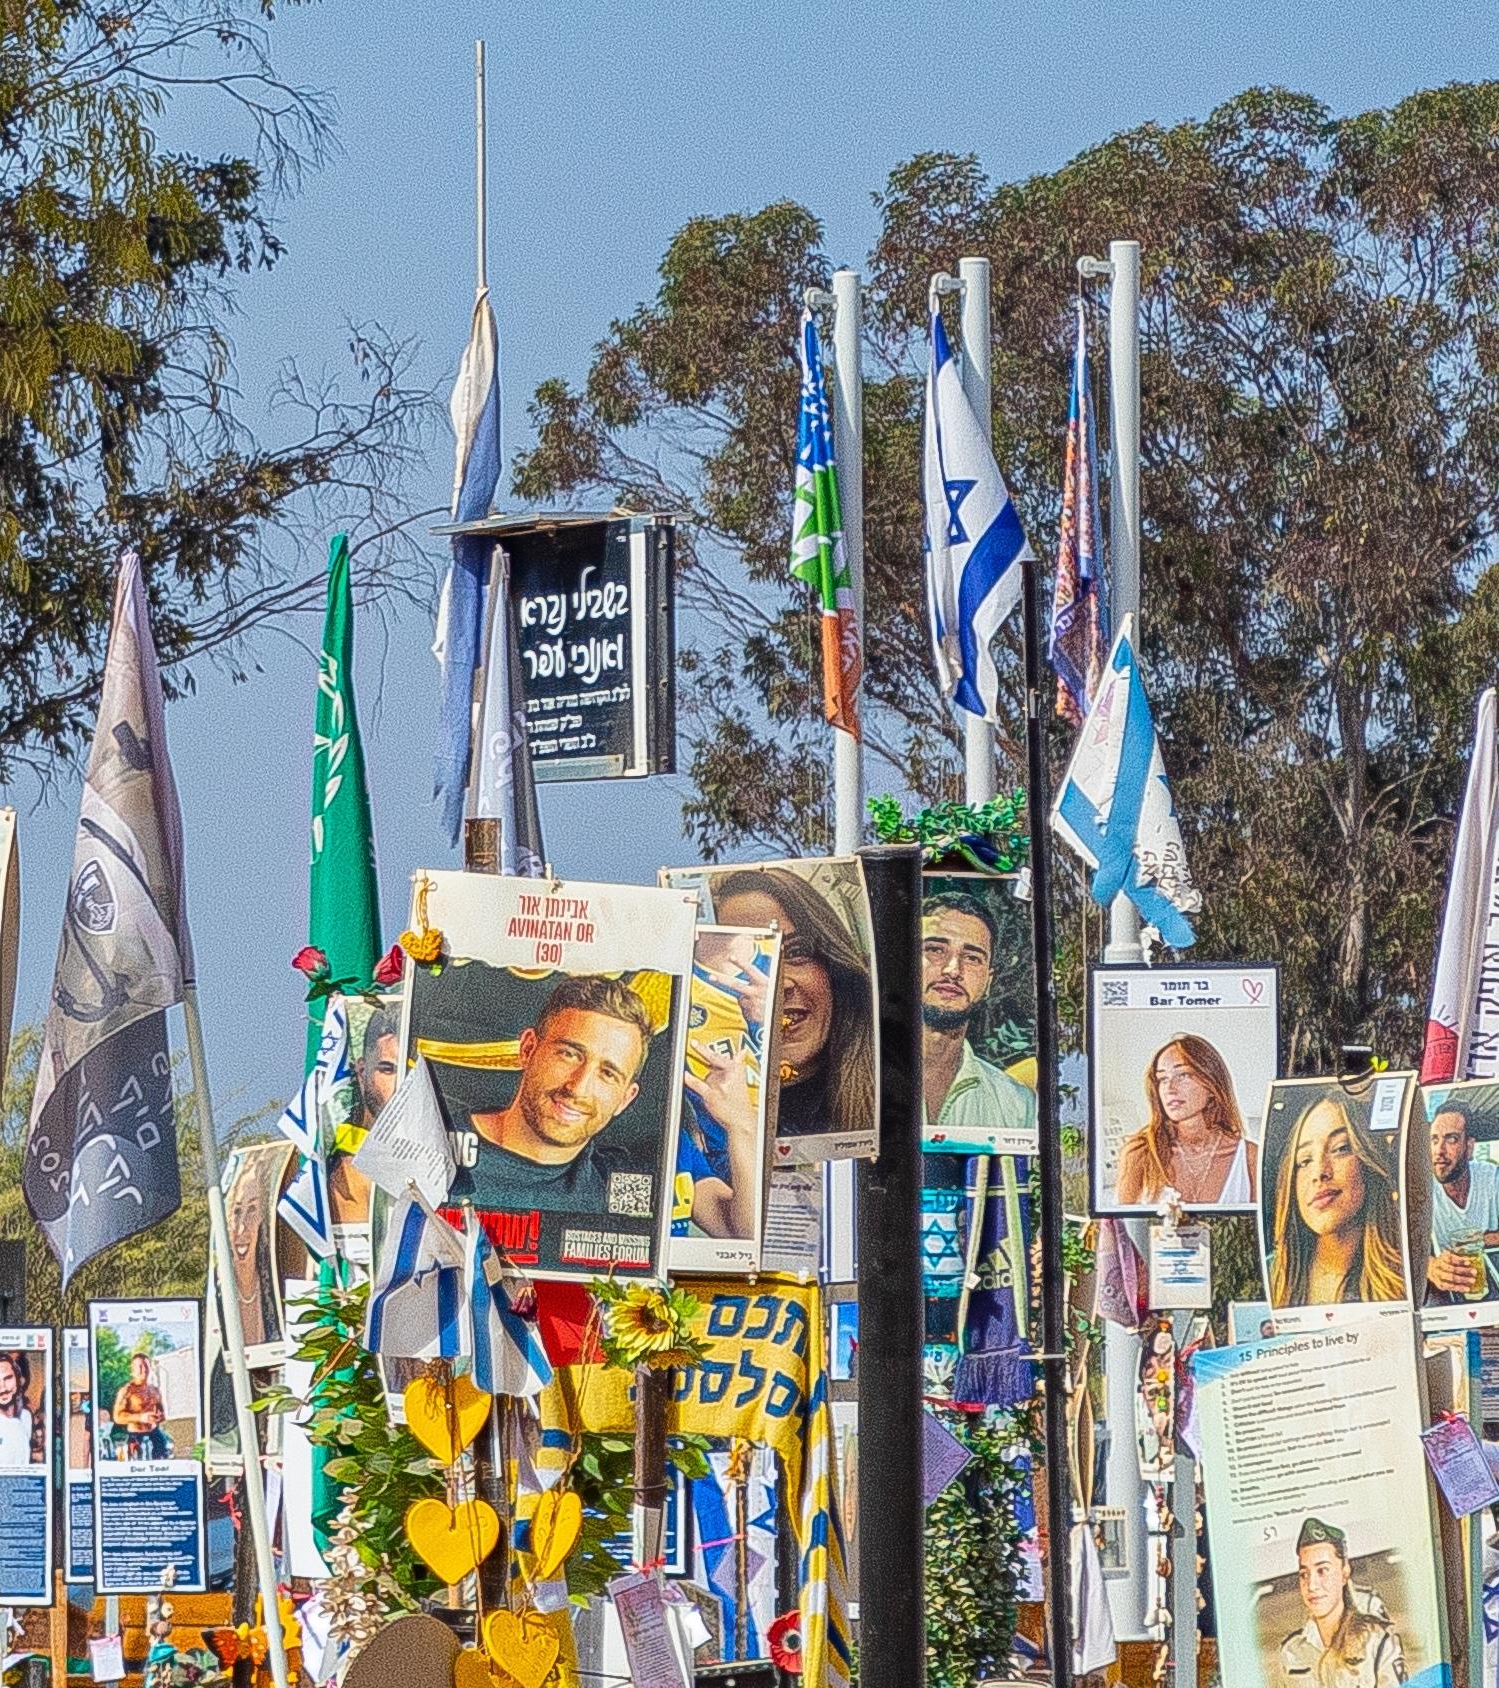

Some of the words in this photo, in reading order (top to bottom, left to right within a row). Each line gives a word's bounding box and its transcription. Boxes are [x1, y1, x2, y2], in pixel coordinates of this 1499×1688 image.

[573, 566, 629, 621] בשבילי
[521, 594, 566, 635] נברא
[523, 638, 565, 679] עפר
[571, 634, 623, 684] ואנוכי
[519, 895, 541, 915] אור
[545, 897, 589, 919] אבינתן
[508, 917, 573, 940] AVINATAN
[576, 923, 594, 943] OR
[536, 941, 563, 965] (30)
[1160, 981, 1190, 990] תומר
[1194, 981, 1209, 990] בר
[1150, 997, 1173, 1005] Bar
[1177, 996, 1221, 1005] Tomer
[564, 1242, 611, 1261] FAMILIES
[614, 1246, 649, 1264] FORUM
[1239, 1352, 1252, 1362] 15
[1256, 1342, 1310, 1360] Principles
[1312, 1339, 1323, 1349] to
[1325, 1336, 1344, 1347] live
[1346, 1332, 1359, 1344] by
